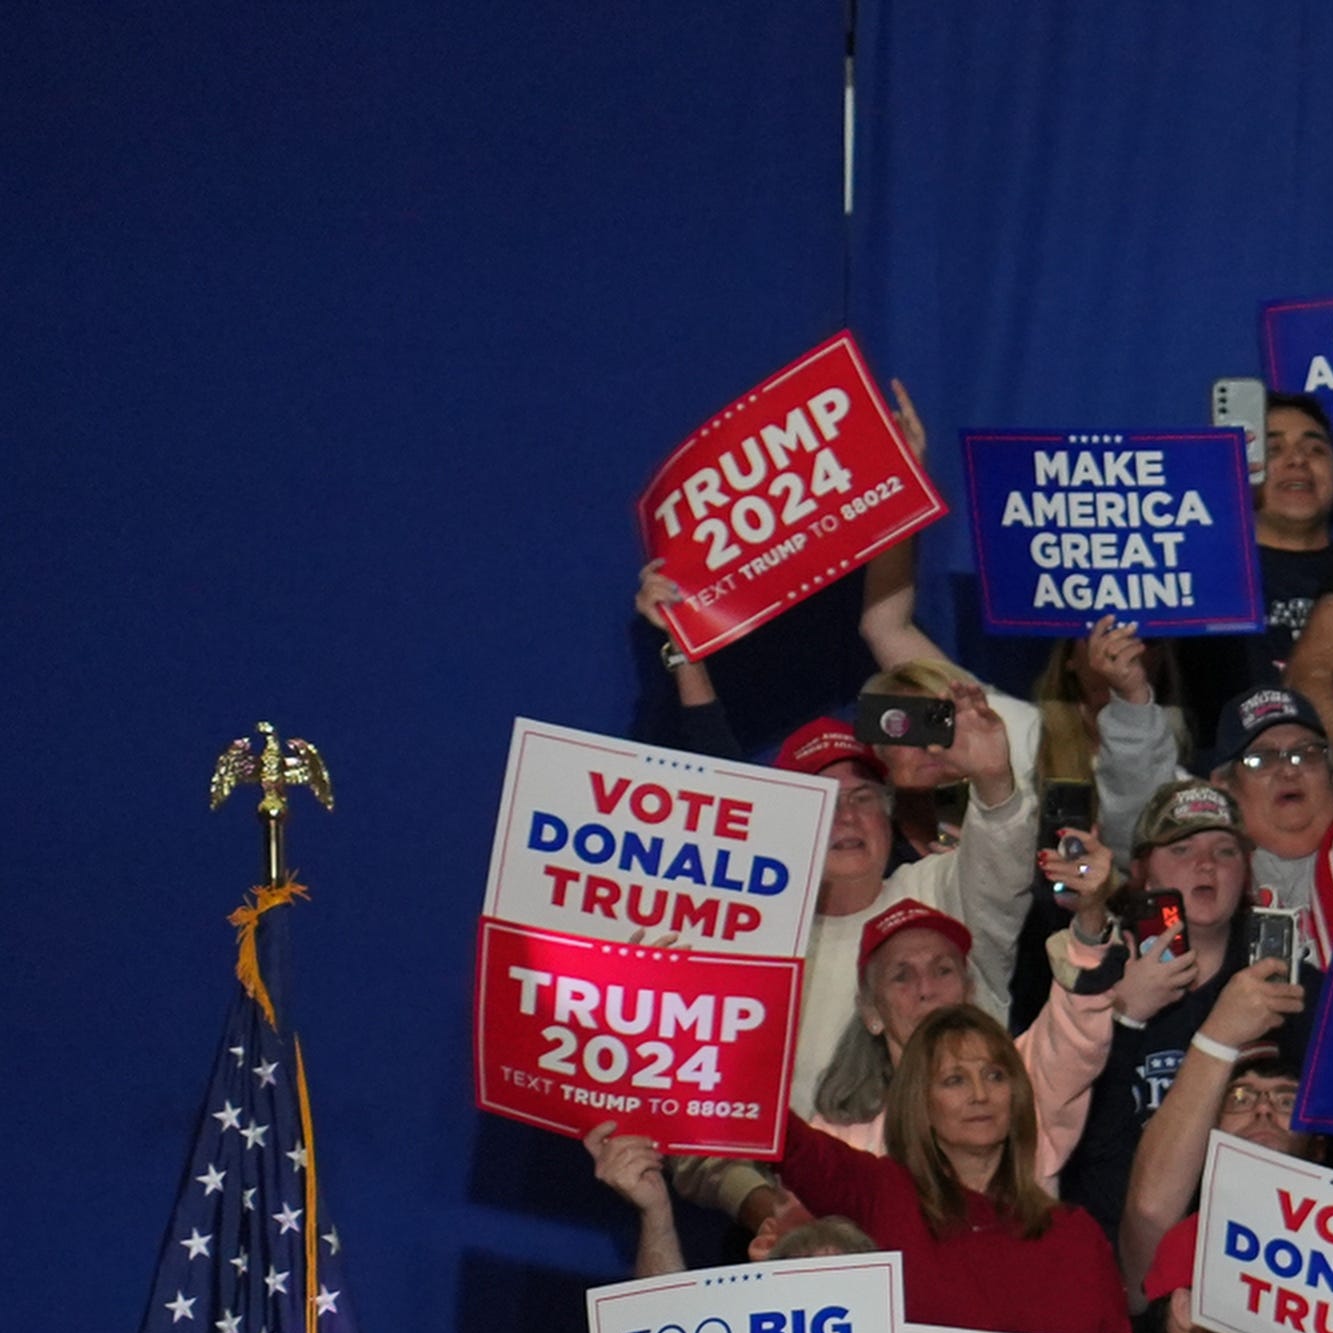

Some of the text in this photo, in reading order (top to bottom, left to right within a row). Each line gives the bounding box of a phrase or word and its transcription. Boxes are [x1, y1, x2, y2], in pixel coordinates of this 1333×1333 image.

[655, 388, 851, 538] TRUMP
[1035, 451, 1166, 486] MAKE
[694, 448, 851, 569] 2024
[1001, 492, 1211, 527] AMERICA
[685, 476, 904, 614] TEXT TRUMP TO 88022
[1030, 533, 1184, 569] GREAT
[1034, 573, 1194, 609] AGAIN!
[589, 771, 754, 841] VOTE
[527, 810, 790, 897] DONALD
[543, 865, 763, 941] TRUMP
[508, 968, 766, 1043] TRUMP
[500, 1065, 760, 1120] TEXT TRUMP TO 88022
[537, 1027, 722, 1092] 2024
